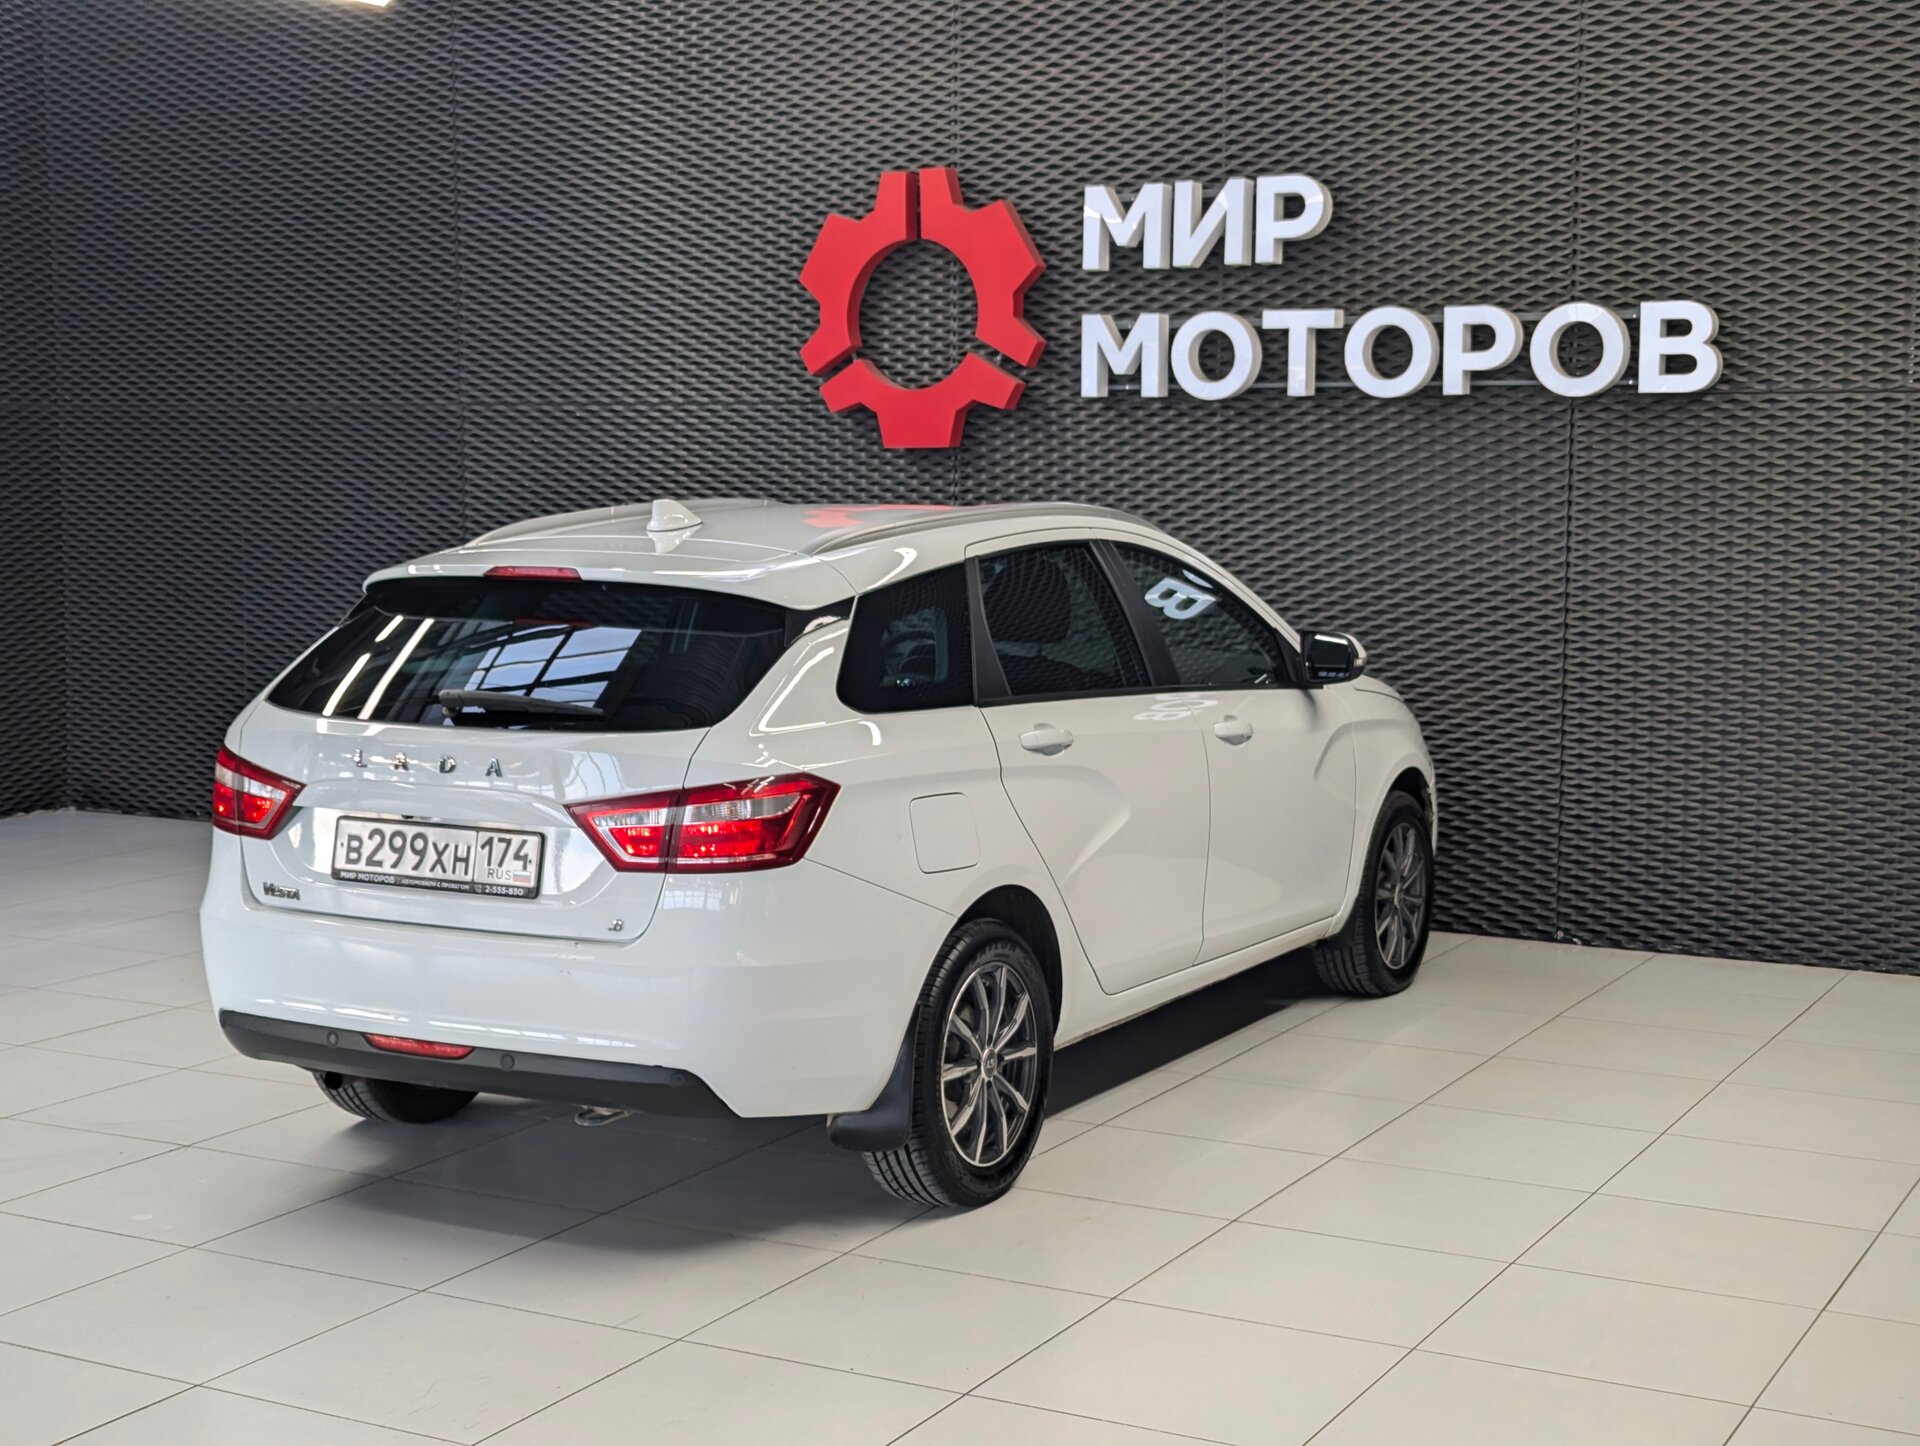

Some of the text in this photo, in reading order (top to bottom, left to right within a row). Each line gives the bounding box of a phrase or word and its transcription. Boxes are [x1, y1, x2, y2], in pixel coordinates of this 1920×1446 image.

[1082, 174, 1333, 271] МИР
[1081, 300, 1723, 400] МОТОРОВ
[353, 748, 503, 778] LADA
[345, 828, 530, 876] В299ХН 174
[340, 871, 357, 879] МИР
[357, 873, 396, 884] МОТОРОВ
[487, 867, 512, 881] RUS
